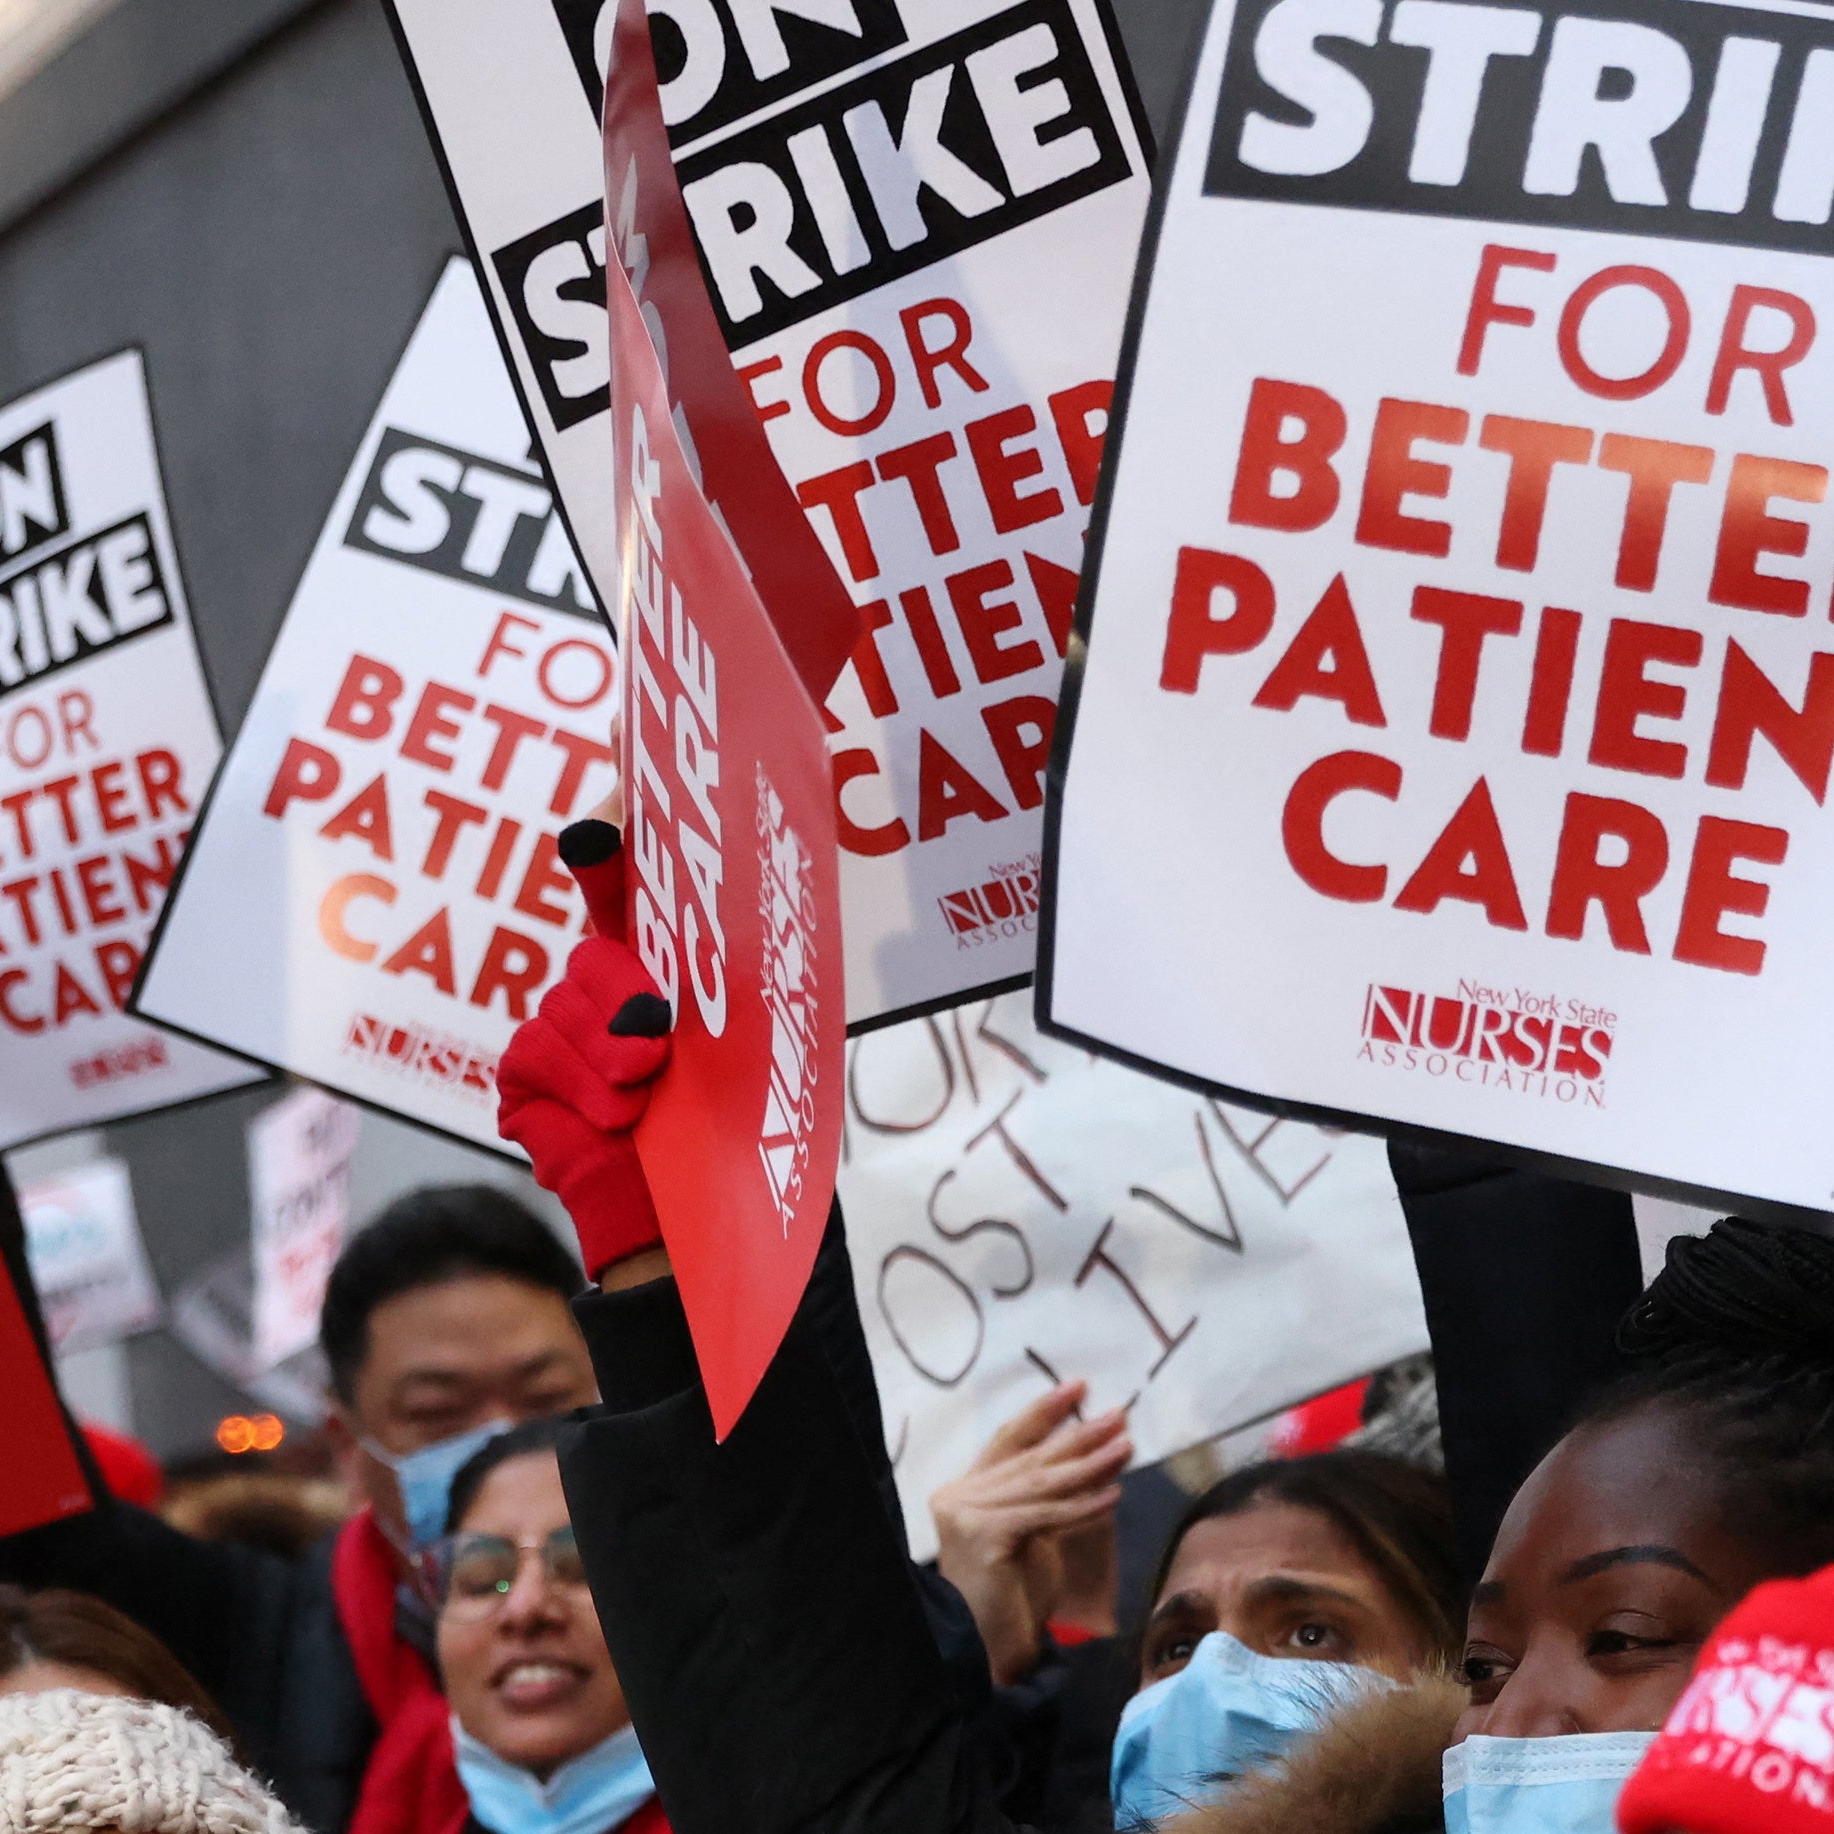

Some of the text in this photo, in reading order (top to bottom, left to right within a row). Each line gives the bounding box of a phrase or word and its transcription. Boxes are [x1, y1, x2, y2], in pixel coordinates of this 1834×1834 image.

[523, 23, 1101, 399] SRIKE
[738, 297, 989, 436] FOR
[1454, 244, 1818, 427] FOR
[797, 379, 1115, 582] TTER
[326, 653, 614, 817] BETT
[478, 612, 615, 708] FO
[631, 404, 678, 1032] BETTER
[263, 737, 597, 938] PATIE
[671, 579, 725, 1039] CARE
[831, 694, 1057, 858] CAR
[937, 868, 1040, 934] NUR
[1281, 750, 1788, 977] CARE
[318, 872, 551, 1020] CAR
[1458, 978, 1617, 1029] New York State
[1357, 1041, 1606, 1109] ASSOCIATION
[1362, 983, 1615, 1082] NURSES
